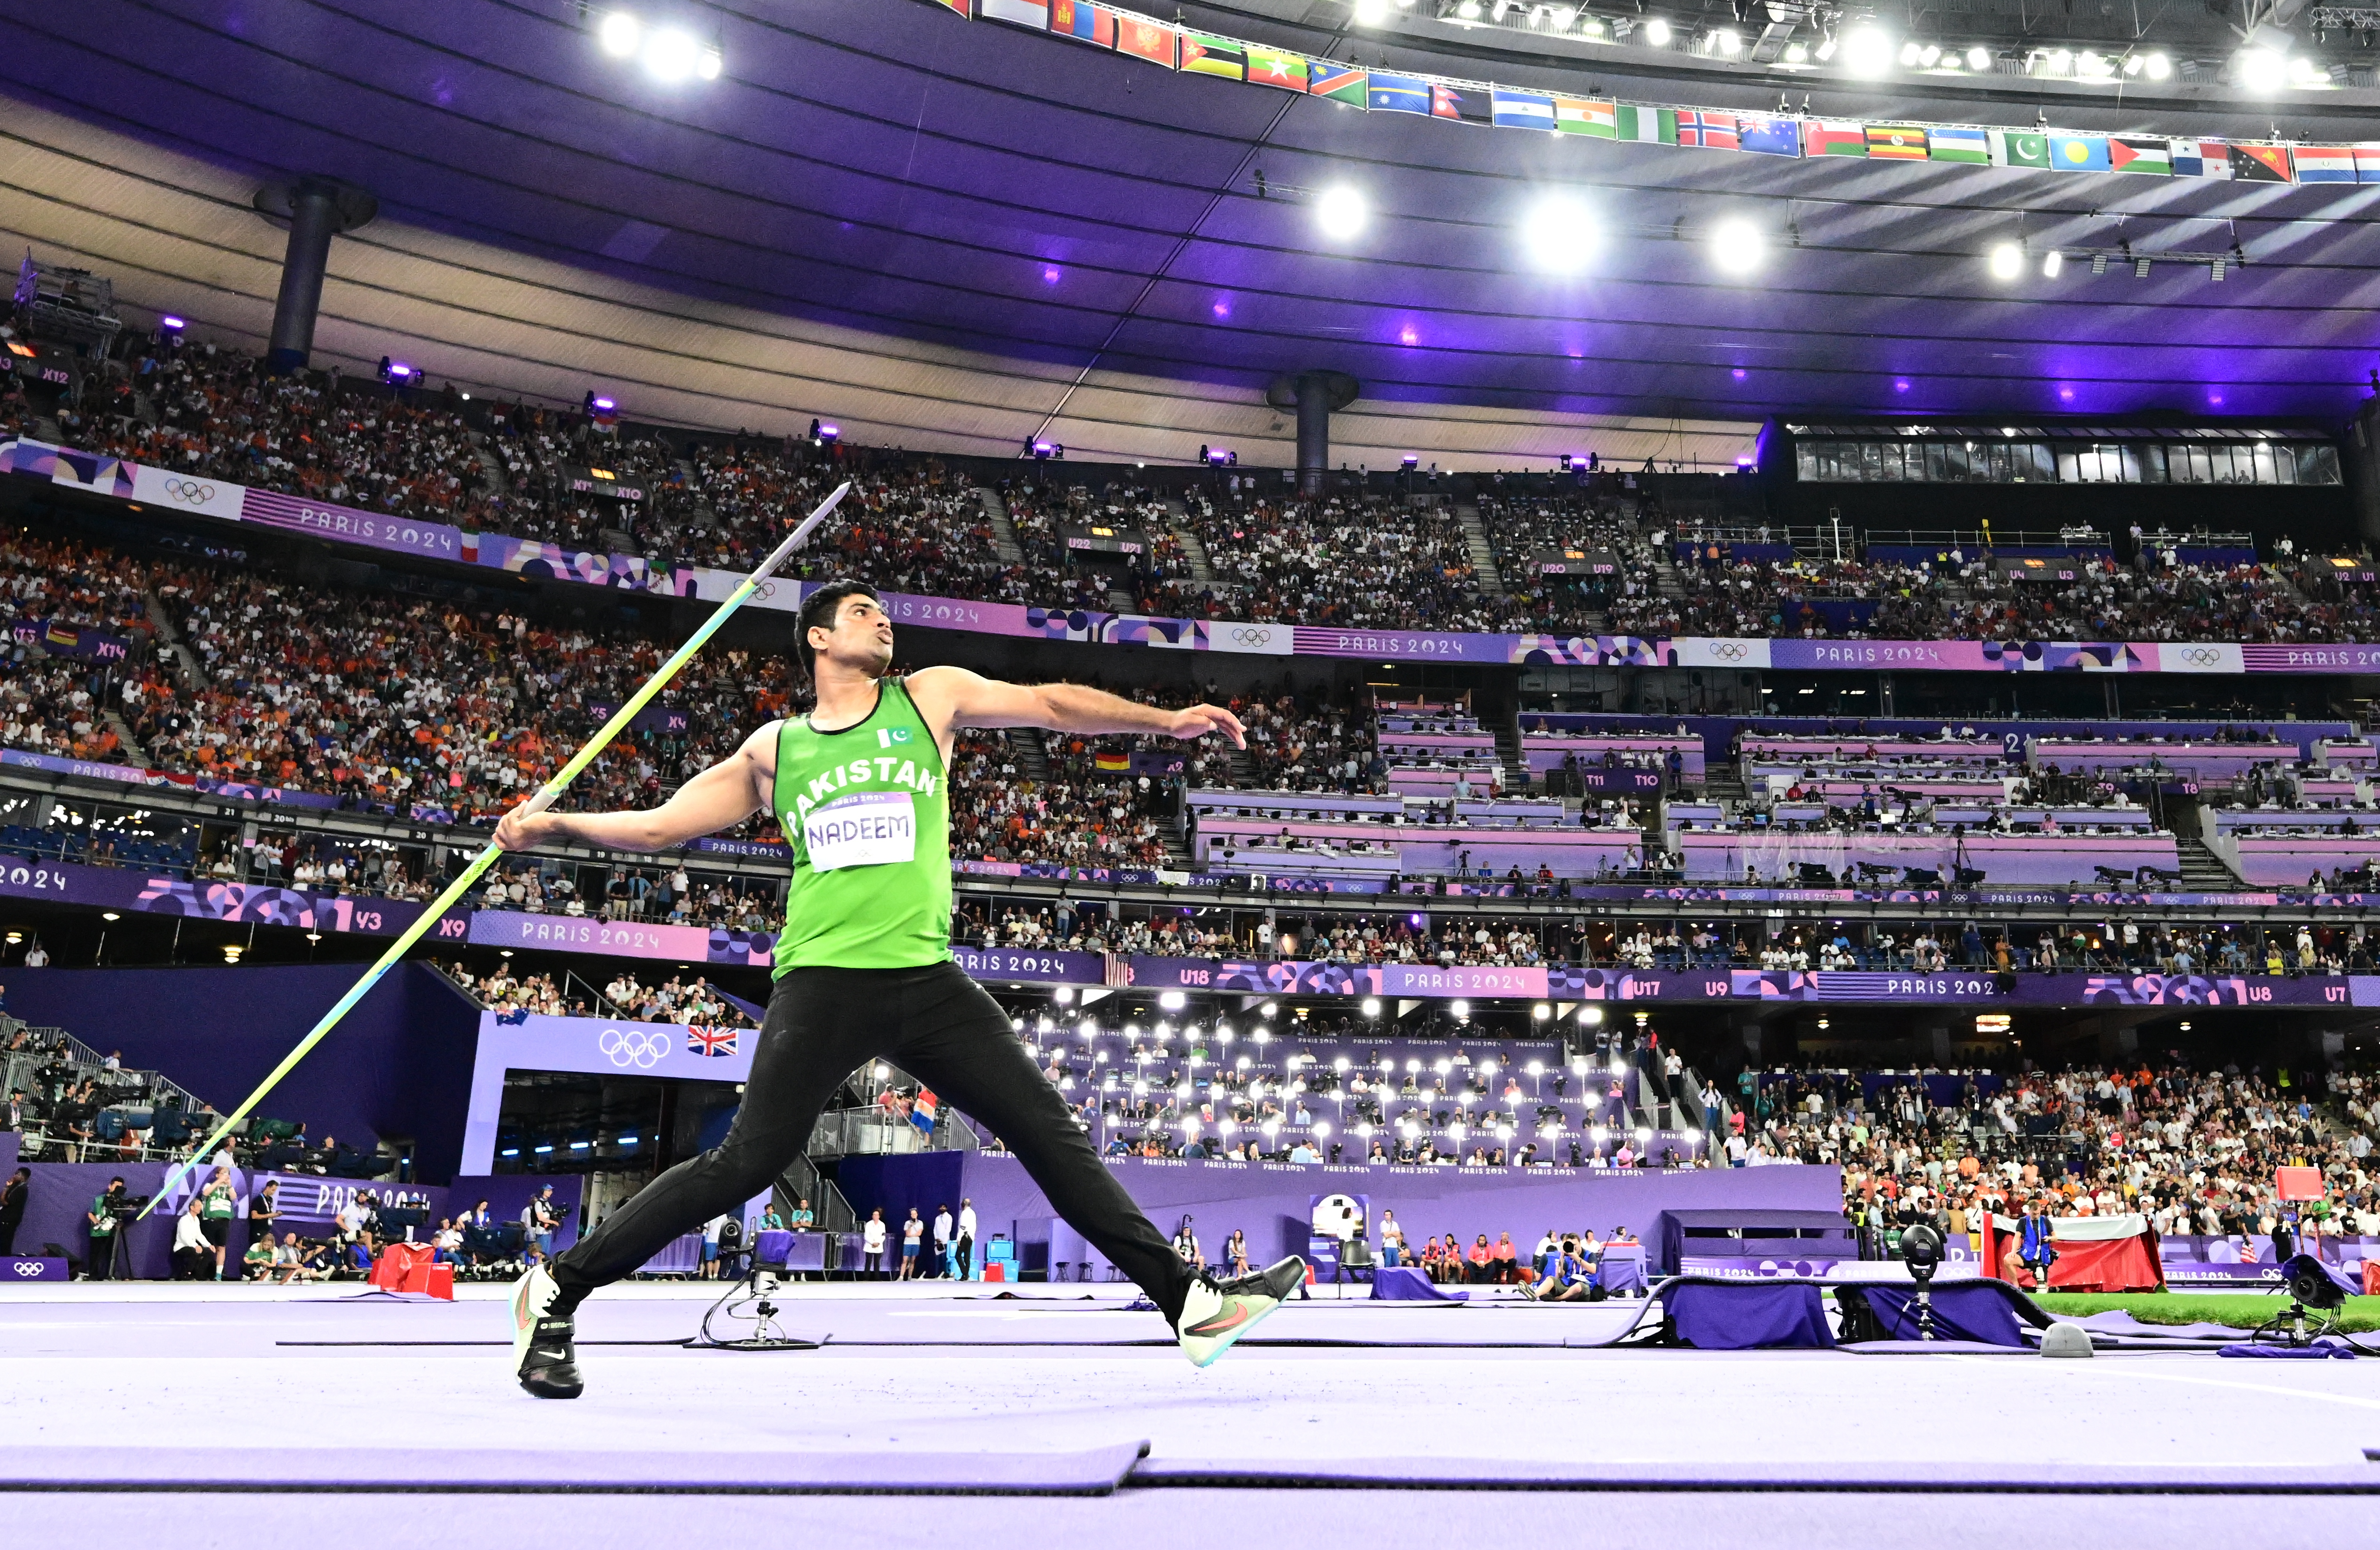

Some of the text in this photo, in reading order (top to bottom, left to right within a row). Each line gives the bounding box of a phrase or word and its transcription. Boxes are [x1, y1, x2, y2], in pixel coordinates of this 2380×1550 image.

[385, 526, 451, 551] 2024
[1069, 537, 1090, 549] U22
[1122, 542, 1141, 553] U21
[1542, 564, 1566, 574] U20
[1593, 564, 1613, 574] U19
[2010, 570, 2024, 579] U4
[2059, 570, 2074, 579] U3
[2335, 571, 2349, 581] U2
[880, 600, 978, 623] RIS 2024
[1408, 639, 1462, 654] 2024
[1884, 647, 1937, 661] 2024
[2357, 652, 2380, 665] 20
[122, 771, 140, 782] 20
[1586, 775, 1604, 786] T11
[1635, 775, 1658, 786] T10
[2183, 783, 2198, 794] T8
[787, 756, 937, 838] PAKISTAN
[416, 830, 426, 840] 20
[808, 816, 909, 849] NADEEM
[752, 846, 782, 858] 2024
[1199, 877, 1222, 887] 202
[439, 919, 466, 937] X9
[601, 928, 659, 948] 2024
[954, 953, 1064, 974] ARIS 2024
[1180, 969, 1210, 985] U18
[1472, 974, 1525, 989] 2024
[1633, 981, 1661, 996] U17
[1705, 981, 1727, 996] U9
[1955, 980, 1995, 995] 202
[2249, 986, 2272, 1001] U8
[2324, 987, 2345, 1002] U7
